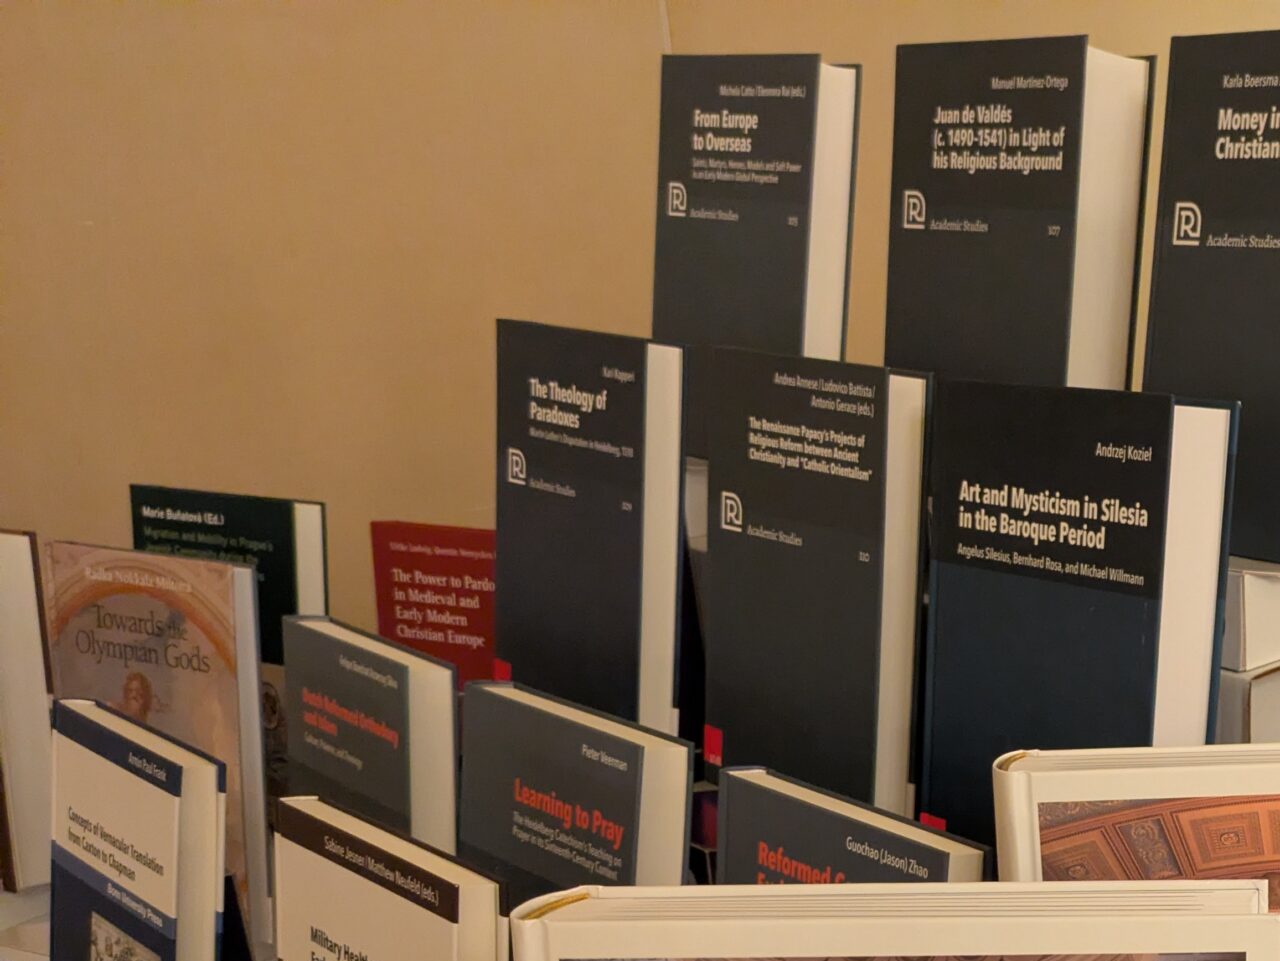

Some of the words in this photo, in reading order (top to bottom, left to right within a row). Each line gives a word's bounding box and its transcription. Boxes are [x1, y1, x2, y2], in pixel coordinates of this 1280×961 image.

[1223, 75, 1243, 88] Karla
[694, 109, 720, 128] From
[722, 109, 758, 134] Europe
[934, 106, 960, 124] Juan
[962, 104, 975, 124] de
[977, 104, 1012, 124] Valdés
[1218, 108, 1267, 135] Money
[693, 133, 704, 150] to
[706, 132, 751, 152] Overseas
[934, 129, 945, 149] (c.
[948, 129, 1008, 150] 1490-1541)
[1009, 129, 1020, 147] in
[1022, 128, 1051, 151] Light
[1052, 126, 1066, 147] of
[933, 152, 948, 169] his
[951, 152, 997, 174] Religious
[1000, 151, 1063, 175] Background
[1206, 234, 1248, 248] Academic
[529, 378, 548, 399] The
[549, 382, 595, 413] Theology
[595, 390, 608, 411] of
[529, 402, 580, 429] Paradoxes
[1096, 442, 1127, 463] Andrzej
[959, 480, 982, 504] Art
[983, 485, 1008, 507] and
[1011, 487, 1080, 518] Mysticism
[1084, 495, 1098, 520] in
[1101, 498, 1149, 528] Silesia
[958, 506, 973, 529] in
[974, 509, 997, 533] the
[1000, 513, 1057, 546] Baroque
[1059, 521, 1105, 550] Period
[957, 543, 985, 560] Angelus
[985, 547, 1012, 565] Silesius,
[1013, 552, 1045, 569] Bernhard
[1045, 556, 1063, 574] Rosa,
[1065, 562, 1080, 576] and
[1080, 563, 1108, 580] Michael
[1109, 568, 1145, 587] Willmann
[90, 604, 166, 637] Towards
[395, 605, 424, 624] Early
[426, 608, 468, 627] Modern
[396, 624, 445, 643] Christian
[447, 629, 485, 649] Europe
[75, 630, 159, 669] Olympian
[164, 643, 211, 674] Gods
[513, 777, 572, 830] Learning
[575, 804, 590, 829] to
[592, 809, 625, 850] Pray
[757, 841, 831, 884] Reformed
[845, 836, 880, 859] Guochao
[880, 848, 908, 874] (Jason)
[908, 858, 929, 879] Zhao
[310, 926, 342, 961] Military
